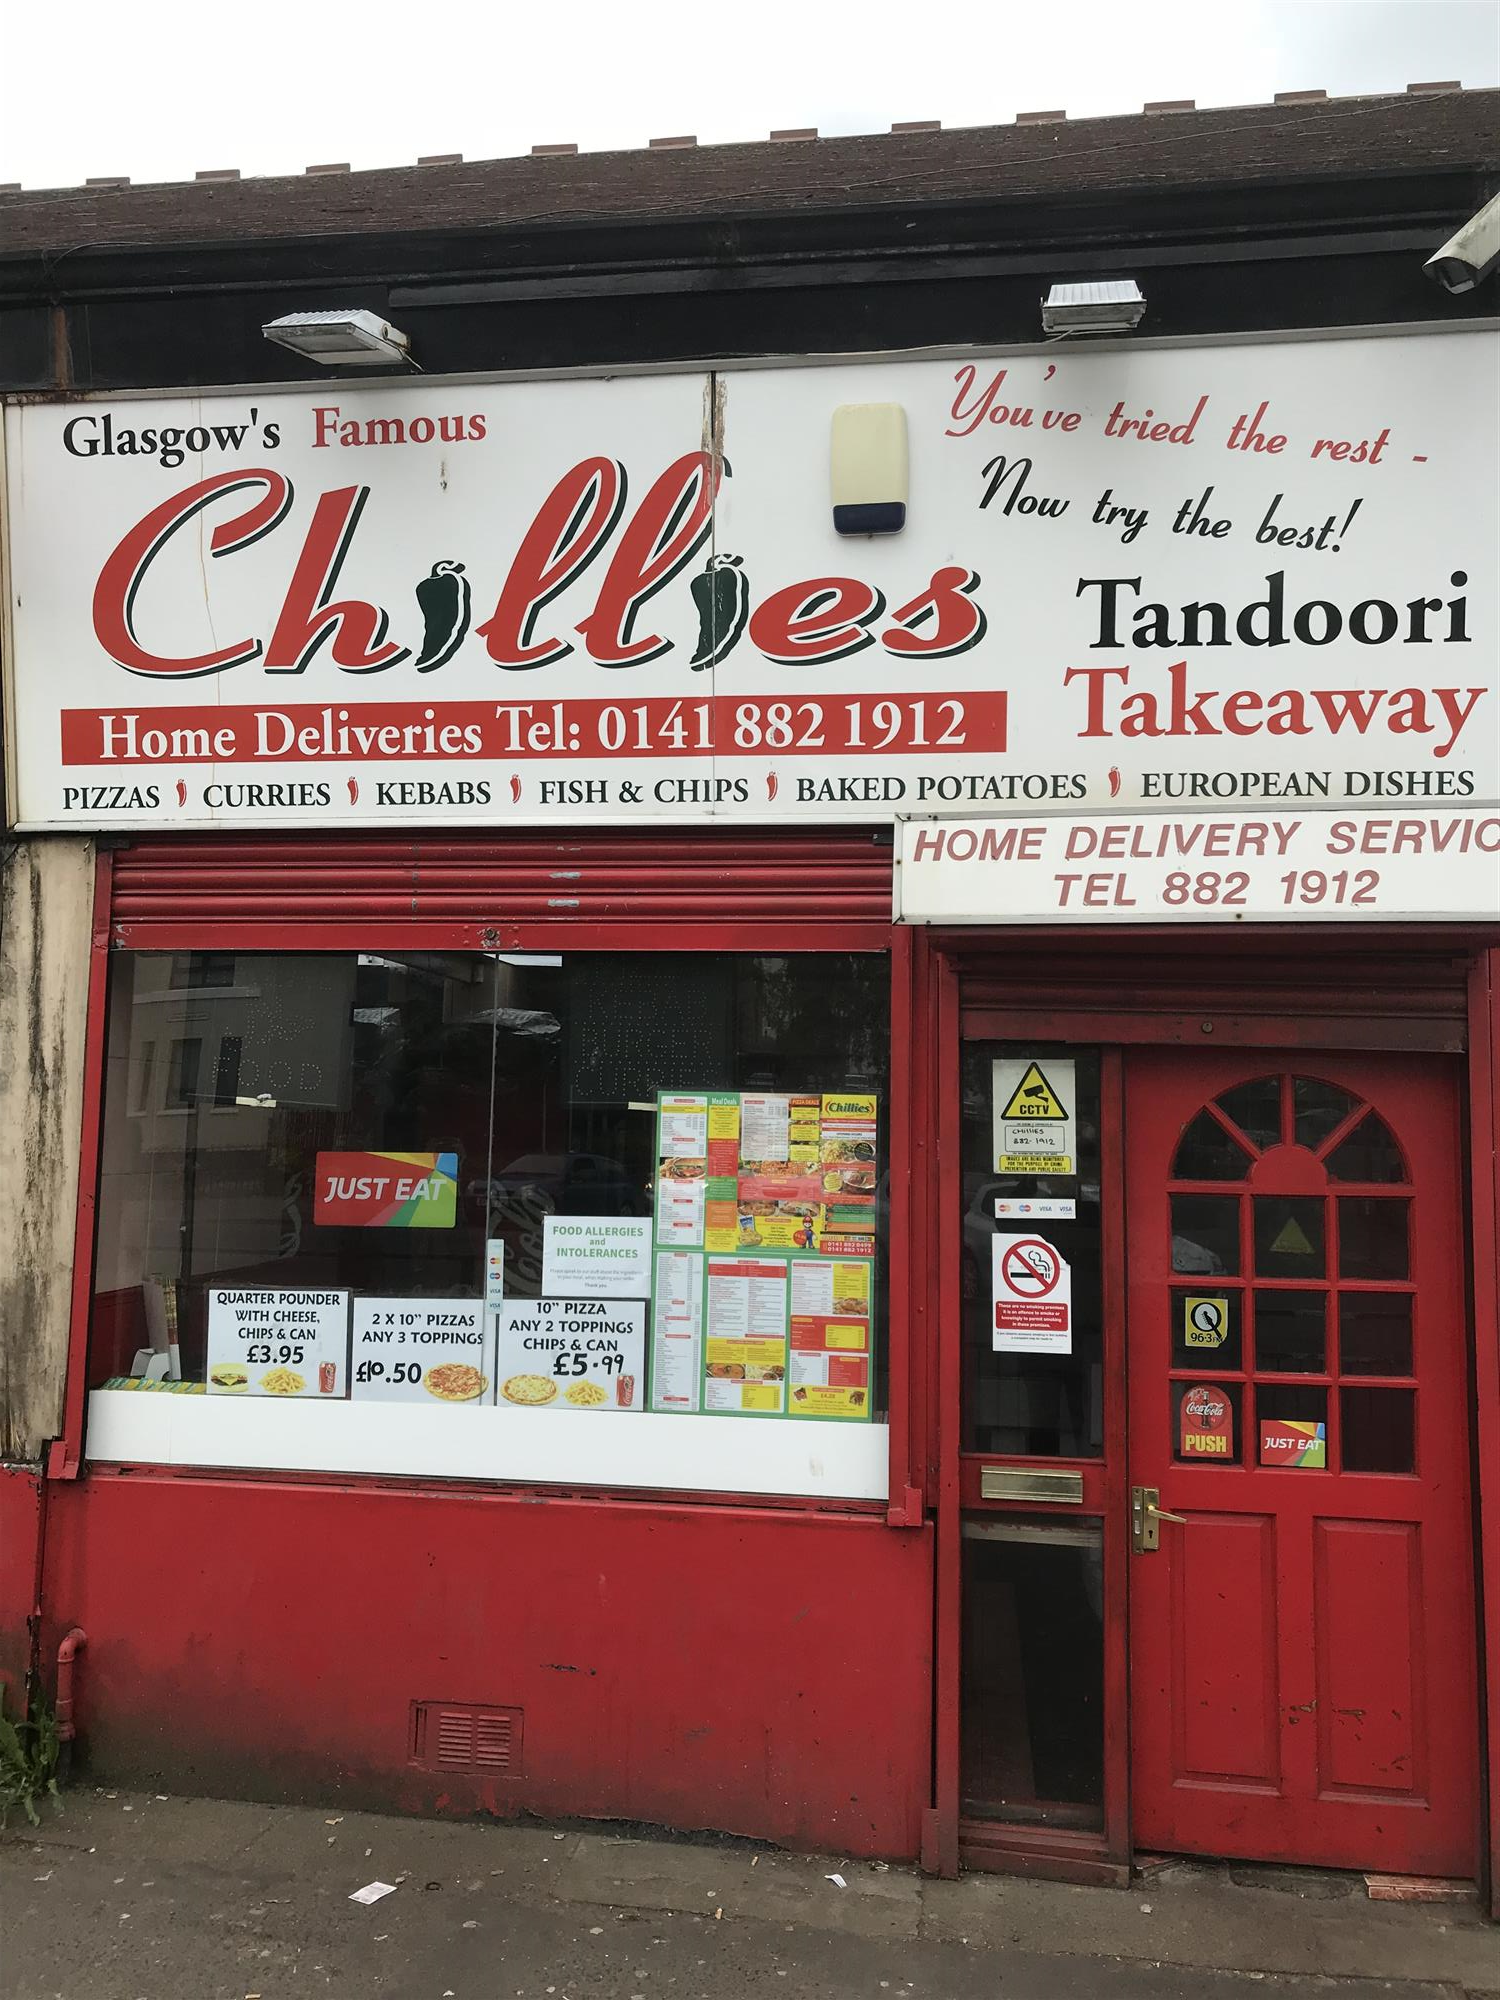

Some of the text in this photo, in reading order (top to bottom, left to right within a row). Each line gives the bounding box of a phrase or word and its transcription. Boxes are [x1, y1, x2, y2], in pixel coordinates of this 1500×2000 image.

[945, 364, 1082, 437] You've
[1103, 394, 1210, 445] tried
[1224, 401, 1288, 455] the
[1310, 428, 1390, 464] rest
[62, 406, 487, 468] Glasgow's Famous
[978, 455, 1363, 552] Now try the best!
[1075, 570, 1472, 648] Tandoori
[1063, 661, 1488, 758] Takeaway
[99, 699, 967, 759] Home Deliveries Tel: 0141 882 1912
[62, 770, 1475, 810] PIZZAS CURRIES KEBABS FISH & CHIPS BAKED POTATOES EUROPEAN DISHES
[913, 818, 1500, 862] HOME DELIVERY SERVIC
[1053, 869, 1380, 907] TEL 882 1912
[211, 1056, 322, 1090] FOOD
[828, 1102, 870, 1113] Chillies
[1019, 1104, 1050, 1115] CCTV
[324, 1177, 448, 1203] JUST EAT
[552, 1226, 644, 1237] FOOD ALLERGIES
[589, 1238, 606, 1246] and
[556, 1248, 639, 1259] INTOLERANCES
[217, 1292, 340, 1305] QUARTER POUNDER
[564, 1303, 607, 1315] PIZZA
[235, 1310, 320, 1323] WITH CHEESE,
[372, 1313, 380, 1325] 2
[385, 1313, 395, 1325] X
[426, 1314, 475, 1326] PIZZAS
[238, 1327, 316, 1340] CHIPS & CAN
[509, 1320, 633, 1334] ANY 2 TOPPINGS
[361, 1331, 483, 1345] ANY 3 TOPPINGS
[523, 1338, 618, 1352] CHIPS & CAN
[246, 1344, 304, 1364] £3.95
[1185, 1434, 1227, 1453] PUSH
[1264, 1437, 1321, 1451] JUST EAT
